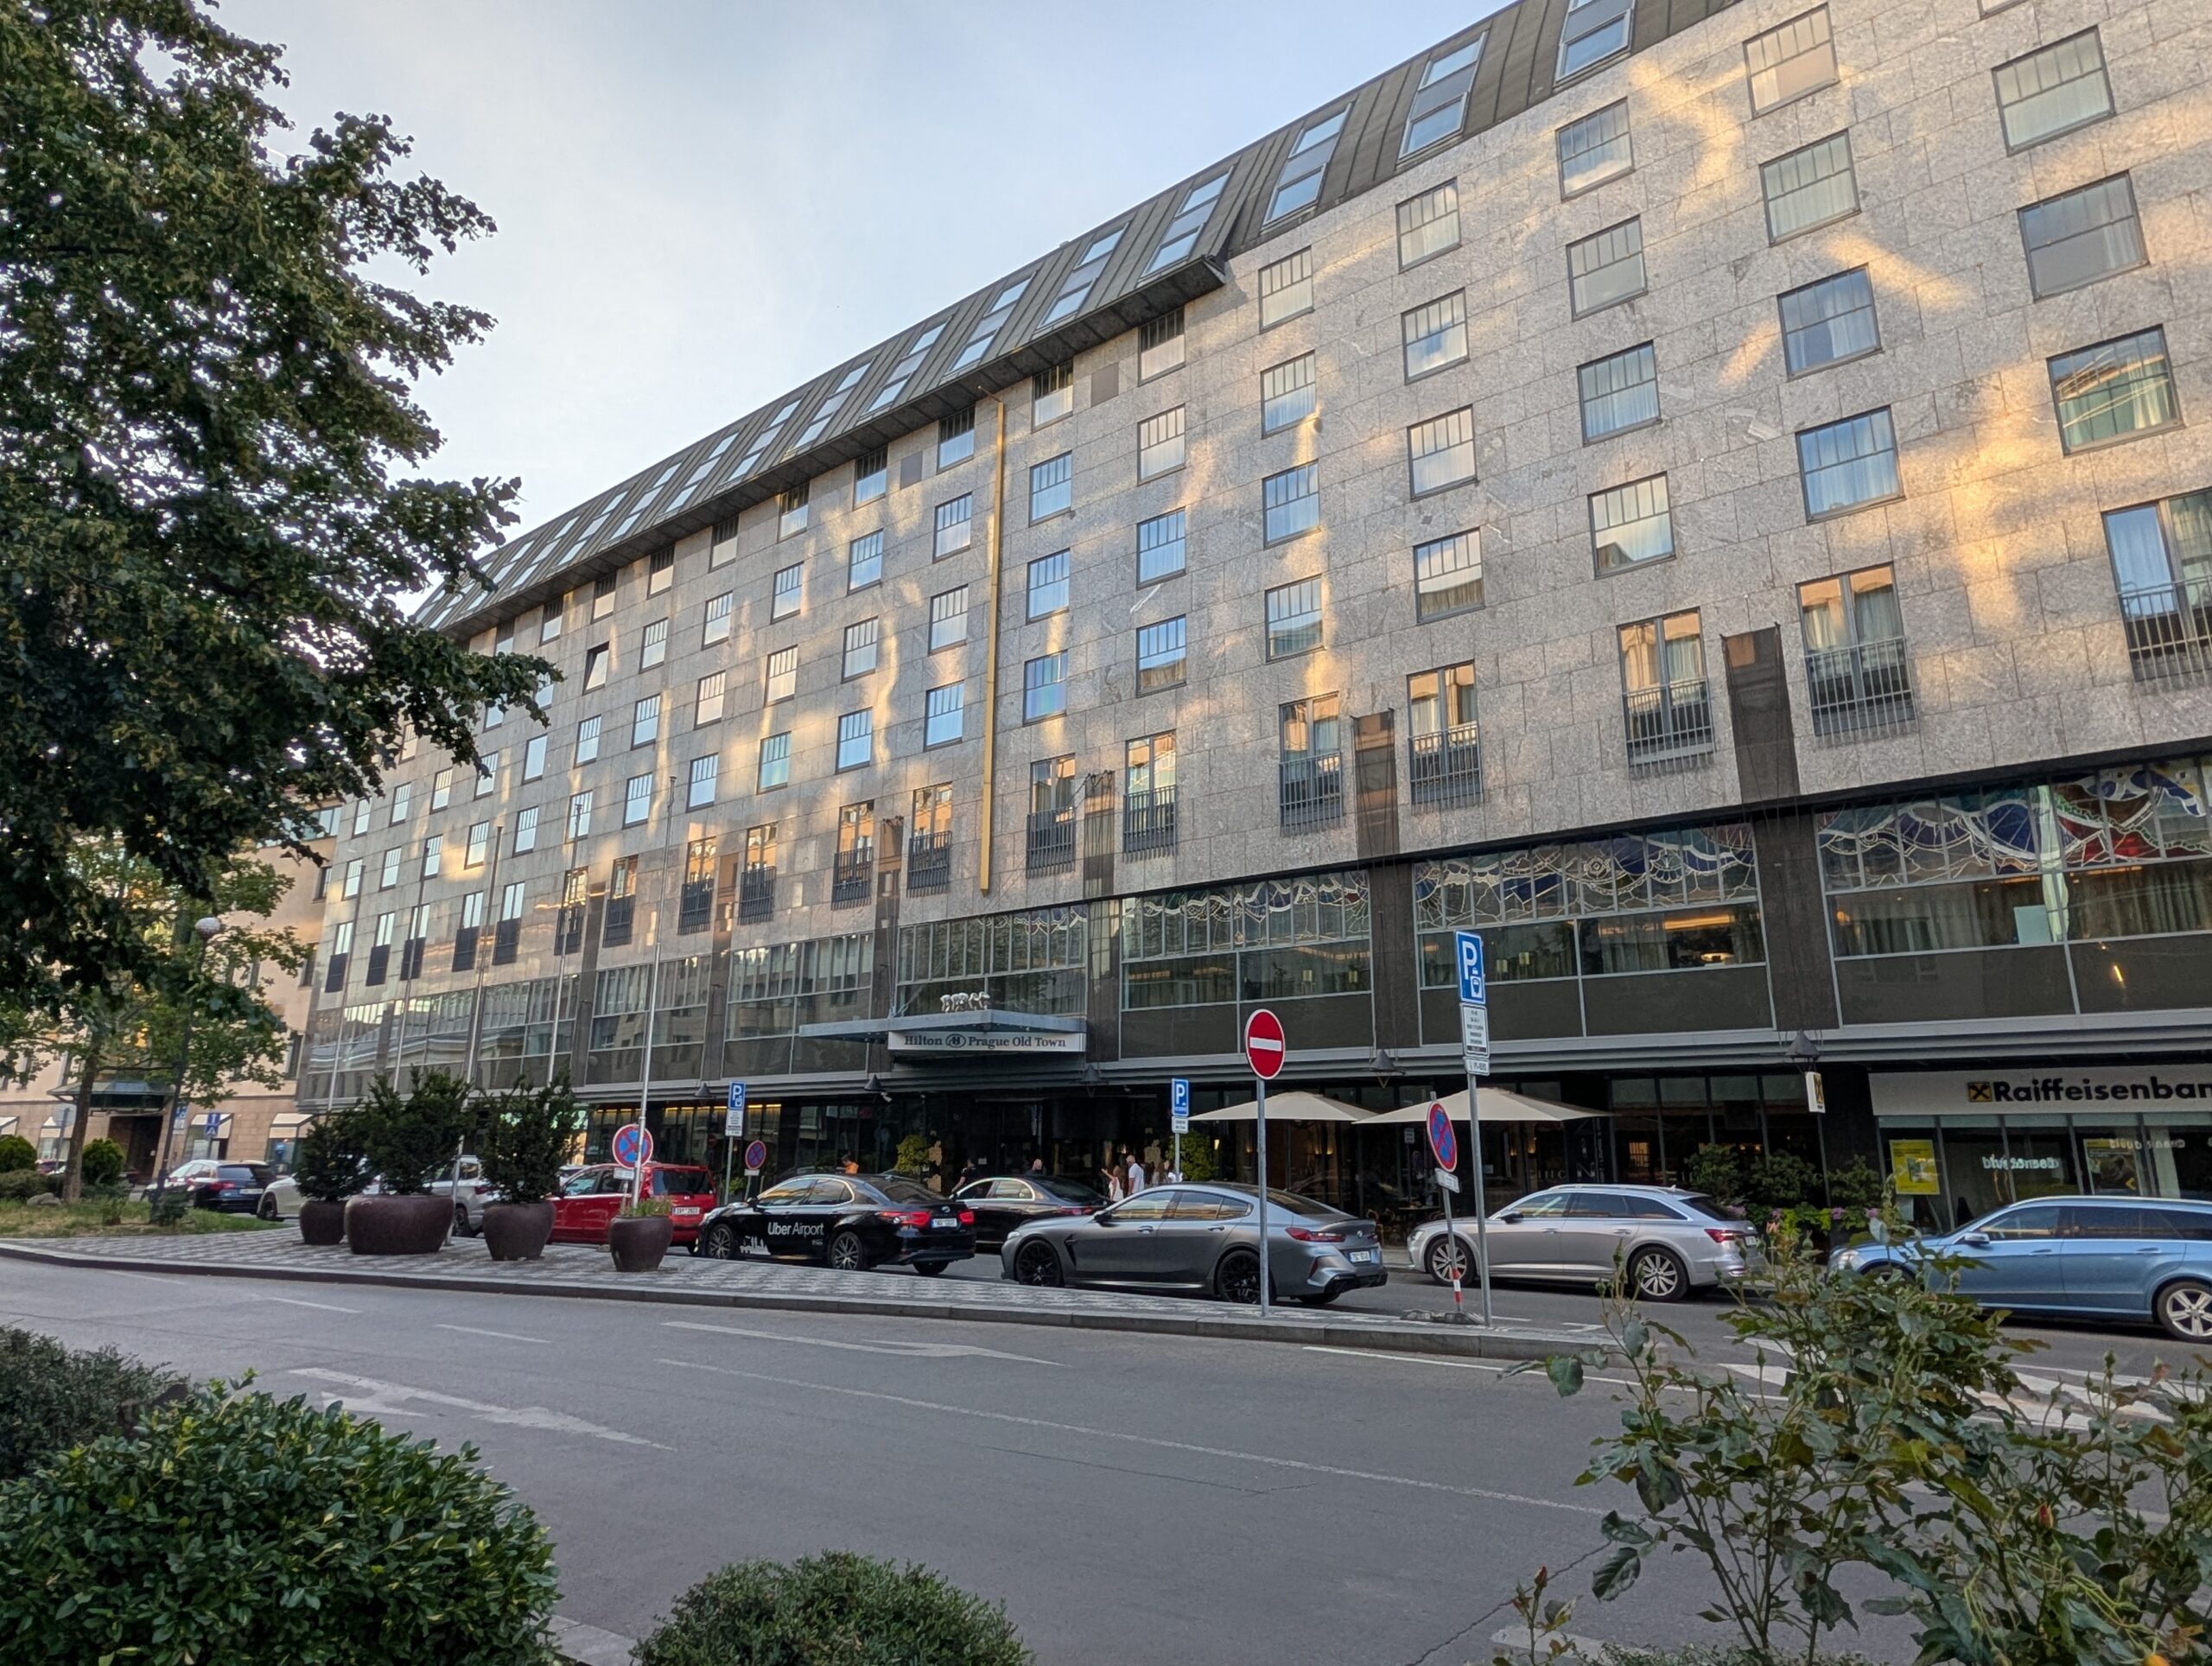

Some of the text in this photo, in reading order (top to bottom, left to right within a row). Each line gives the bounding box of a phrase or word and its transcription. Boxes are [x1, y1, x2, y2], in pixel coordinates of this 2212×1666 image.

[1462, 940, 1478, 980] P
[904, 1035, 943, 1046] Hilton
[969, 1037, 1009, 1049] Prague
[1012, 1036, 1032, 1046] Old
[1035, 1037, 1066, 1047] Town
[732, 1084, 742, 1100] P
[1176, 1084, 1185, 1104] P
[1993, 1076, 2212, 1102] Raiffeisenban
[767, 1222, 824, 1237] Uber Airport
